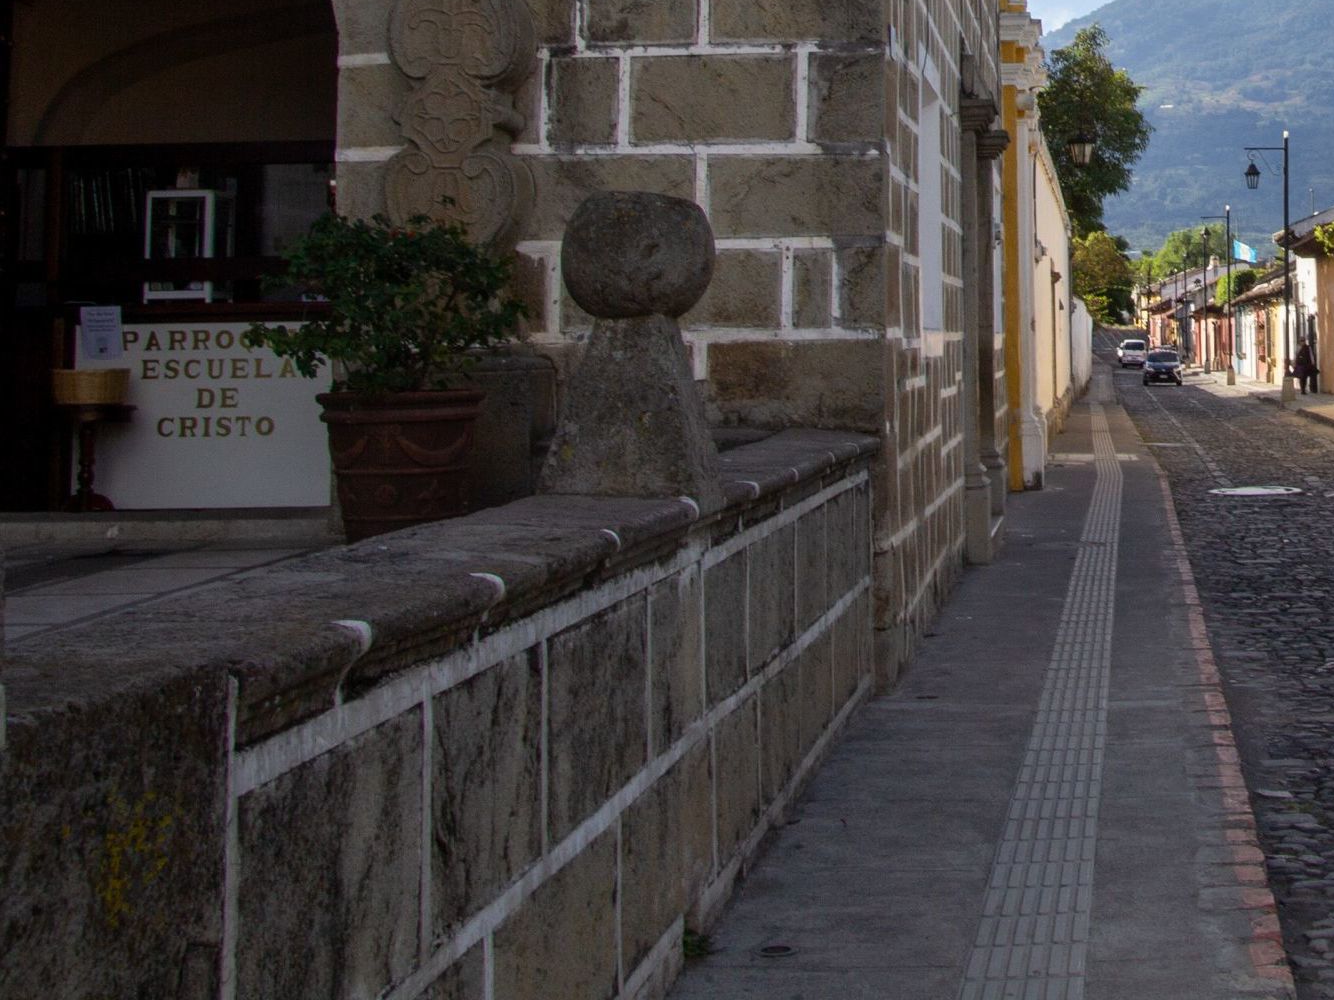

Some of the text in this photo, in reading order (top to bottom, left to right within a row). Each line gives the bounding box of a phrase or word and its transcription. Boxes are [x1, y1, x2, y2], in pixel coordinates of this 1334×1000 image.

[122, 329, 298, 352] PARROQ
[142, 358, 298, 380] ESCUELA
[196, 387, 239, 409] DE
[156, 416, 276, 438] CRISTO
